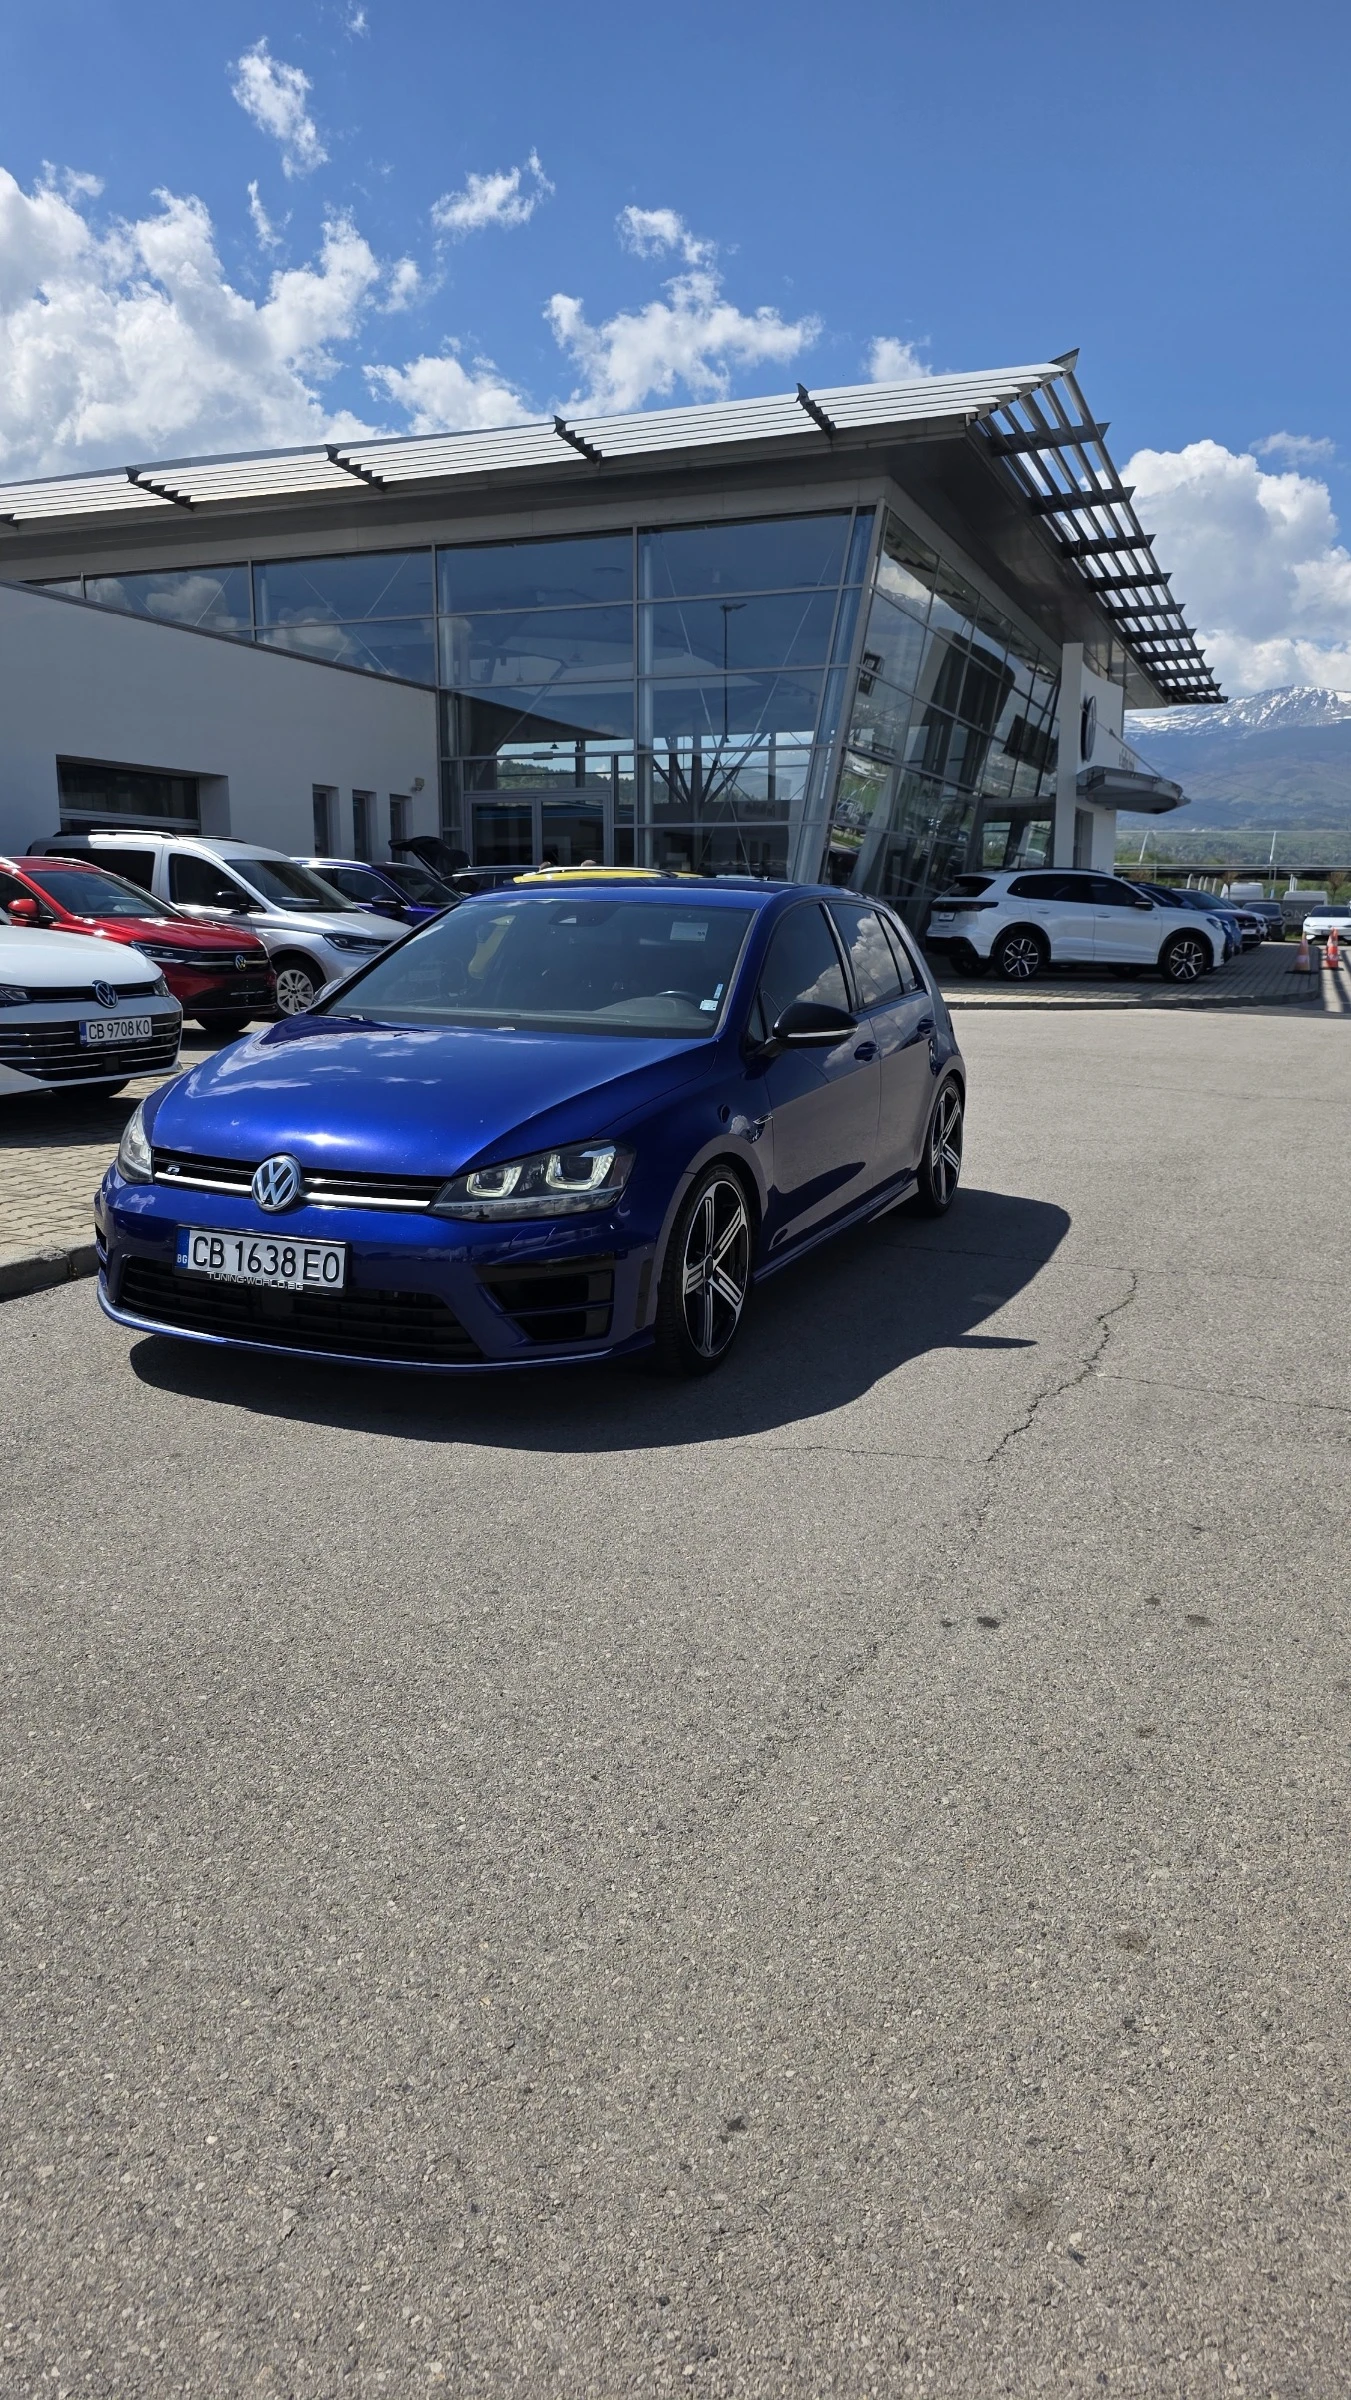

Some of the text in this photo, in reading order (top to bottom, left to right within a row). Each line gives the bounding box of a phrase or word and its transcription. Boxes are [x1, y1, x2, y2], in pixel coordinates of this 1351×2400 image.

[88, 1024, 105, 1040] CB
[107, 1021, 135, 1038] 9708
[136, 1019, 150, 1036] KO
[176, 1253, 188, 1264] BG
[193, 1236, 340, 1283] CB 1638 EO
